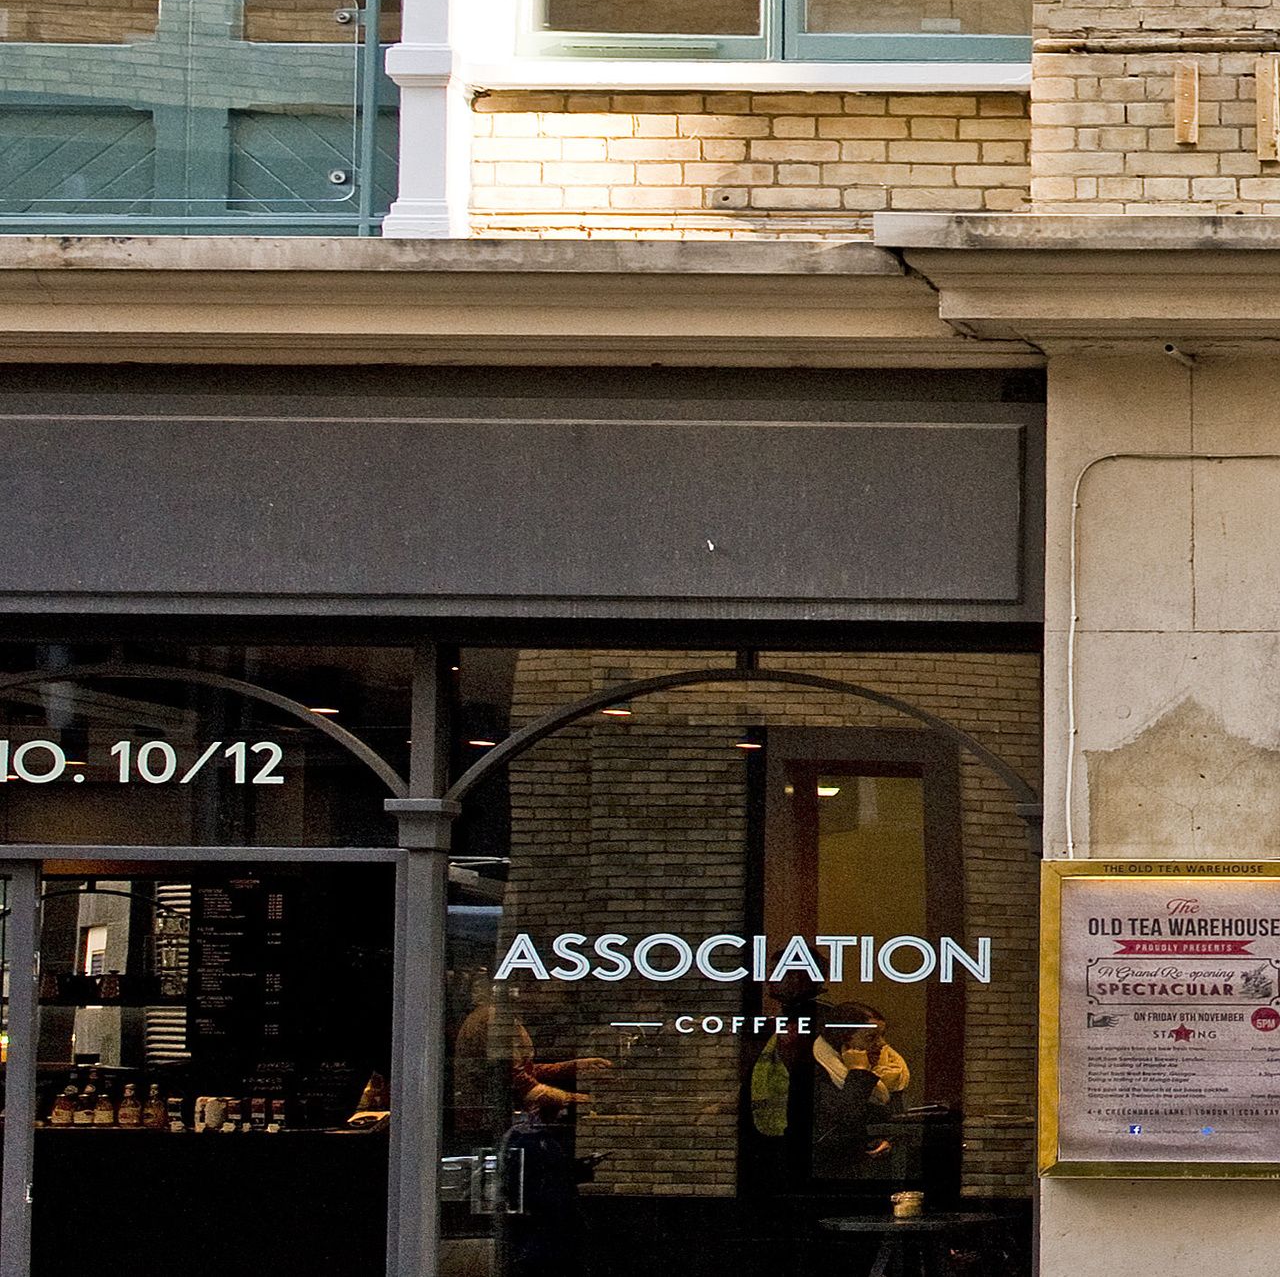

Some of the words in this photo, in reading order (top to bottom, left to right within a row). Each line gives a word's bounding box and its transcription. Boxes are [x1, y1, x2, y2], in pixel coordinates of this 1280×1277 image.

[0, 739, 86, 784] O.
[110, 740, 285, 784] 10/12
[1103, 864, 1125, 873] THE
[1128, 864, 1153, 873] OLD
[1158, 864, 1181, 873] TEA
[1187, 864, 1265, 873] WAREHOUSE
[1166, 898, 1200, 915] The
[1088, 918, 1122, 936] OLD
[1128, 918, 1163, 936] TEA
[1168, 918, 1280, 936] WAREHOUSE
[1135, 943, 1178, 952] PROUDLY
[1183, 943, 1233, 952] PRESENTS
[494, 933, 991, 983] ASSOCIATION
[1115, 966, 1158, 983] Grand
[1161, 966, 1235, 984] Re-opening
[1097, 982, 1234, 997] SPECTACULAR
[675, 1016, 812, 1034] COFFEE
[1134, 1012, 1147, 1022] ON
[1148, 1012, 1177, 1022] FRIDAY
[1198, 1012, 1245, 1022] NOVEMBER
